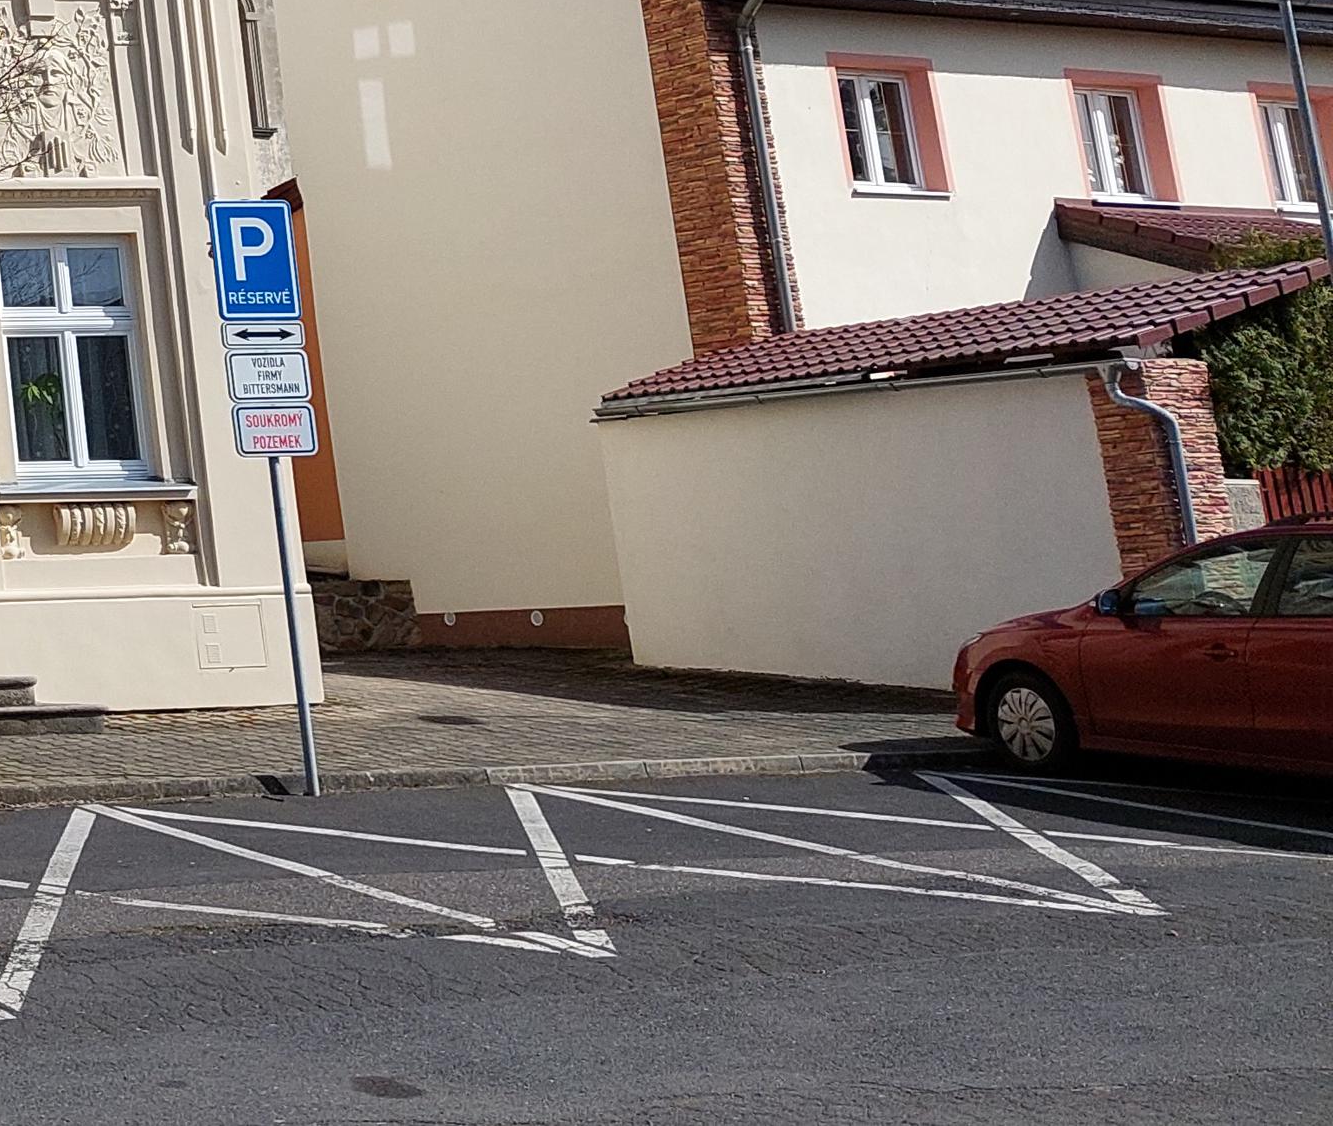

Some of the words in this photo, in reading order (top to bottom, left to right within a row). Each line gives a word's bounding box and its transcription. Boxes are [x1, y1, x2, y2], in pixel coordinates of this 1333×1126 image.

[229, 217, 275, 281] P
[228, 288, 291, 304] RÉSERVÉ
[251, 357, 285, 368] VOZIDLA
[257, 370, 282, 381] FIRMY
[243, 382, 300, 395] BITTERSMANN
[245, 410, 303, 428] SOUKROMÝ
[253, 435, 302, 449] POZEMEK
